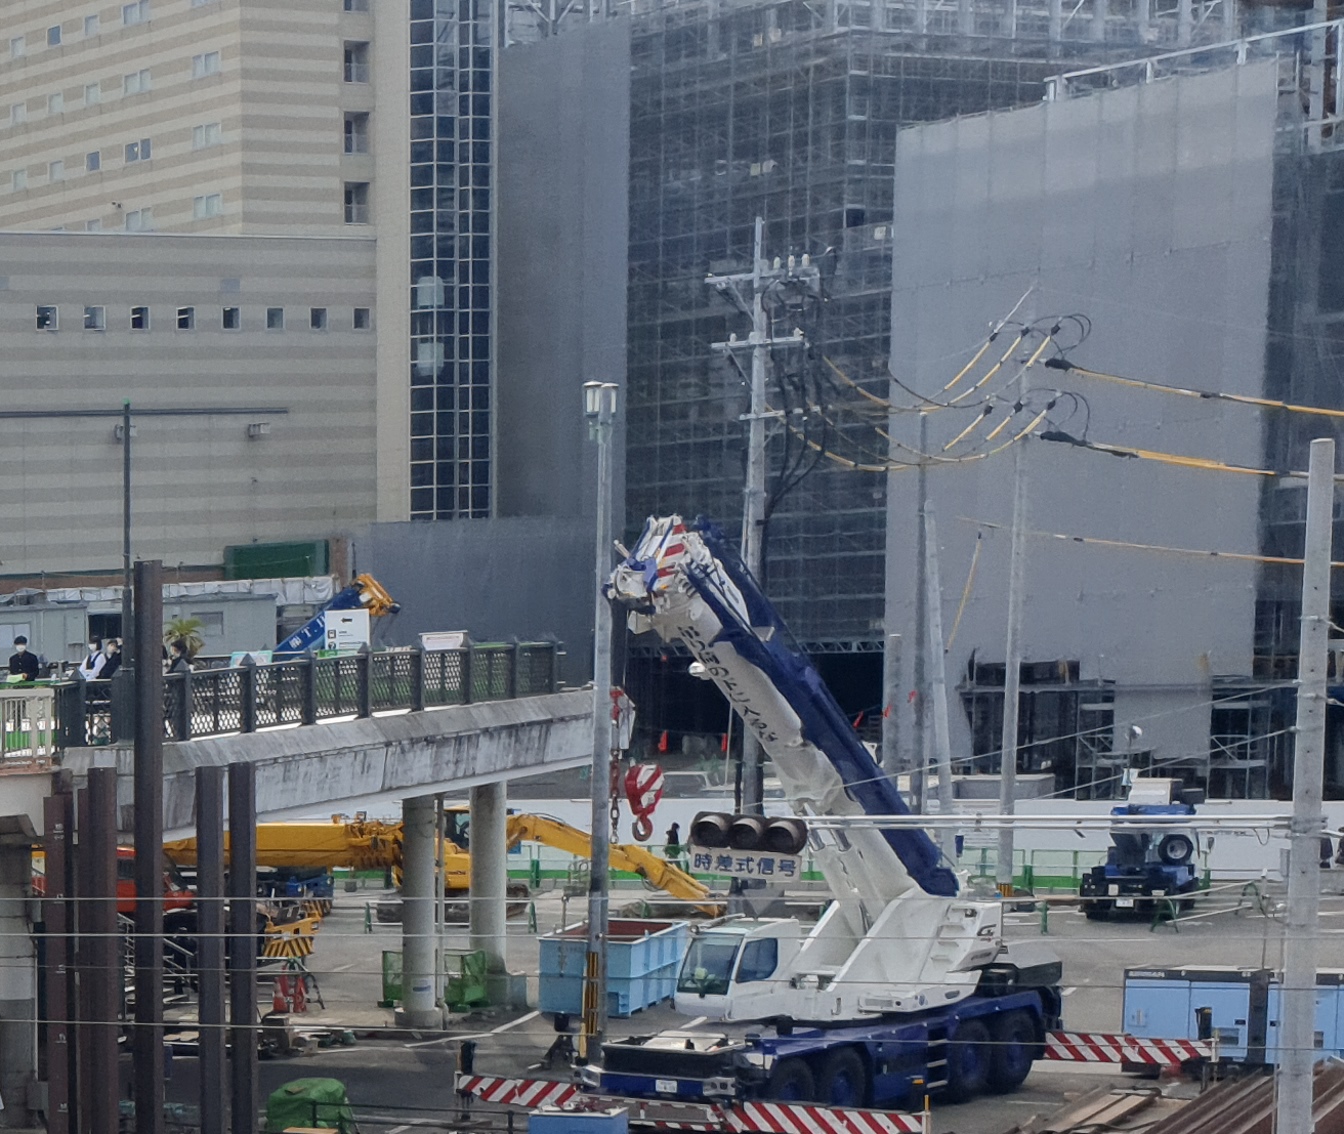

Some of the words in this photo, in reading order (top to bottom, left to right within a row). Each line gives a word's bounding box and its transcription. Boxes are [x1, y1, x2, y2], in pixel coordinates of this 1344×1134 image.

[694, 853, 797, 877] 時差式信号
